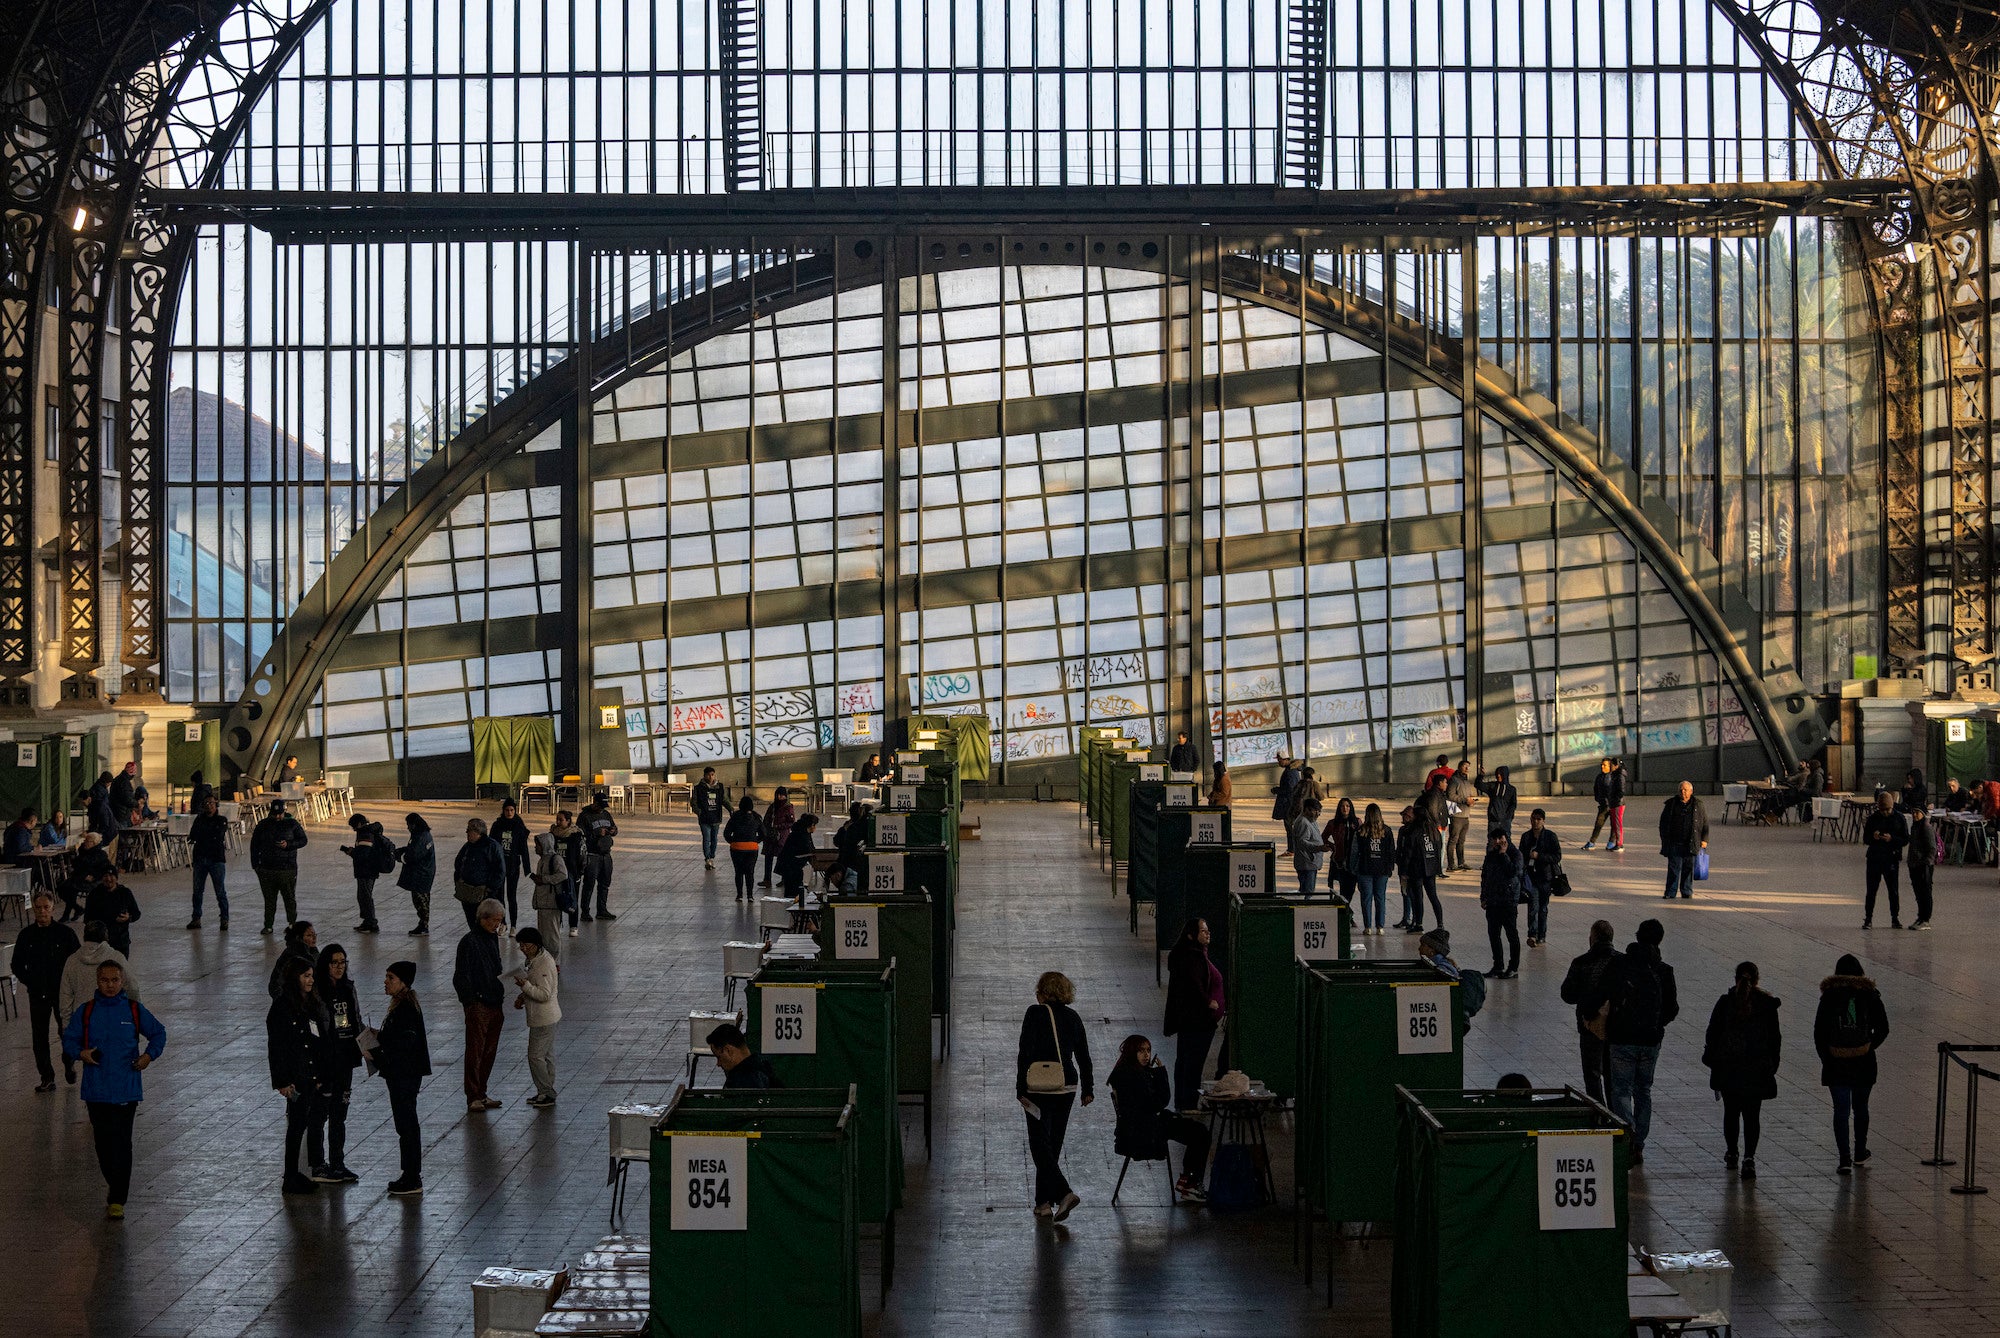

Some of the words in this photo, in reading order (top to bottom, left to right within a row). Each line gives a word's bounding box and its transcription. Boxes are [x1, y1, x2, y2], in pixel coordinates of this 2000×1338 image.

[881, 833, 898, 844] 850
[1198, 831, 1214, 843] 859
[1370, 843, 1381, 851] VEL
[875, 865, 894, 873] MESA
[874, 875, 896, 889] 851
[1238, 874, 1256, 888] 858
[845, 920, 867, 928] MESA
[1303, 921, 1326, 930] MESA
[845, 930, 868, 947] 852
[1303, 931, 1327, 949] 857
[775, 1004, 803, 1014] MESA
[1410, 1002, 1438, 1013] MESA
[775, 1017, 802, 1040] 853
[1409, 1016, 1438, 1038] 856
[688, 1159, 727, 1173] MESA
[1556, 1159, 1595, 1173] MESA
[688, 1178, 731, 1209] 854
[1555, 1178, 1597, 1208] 855
